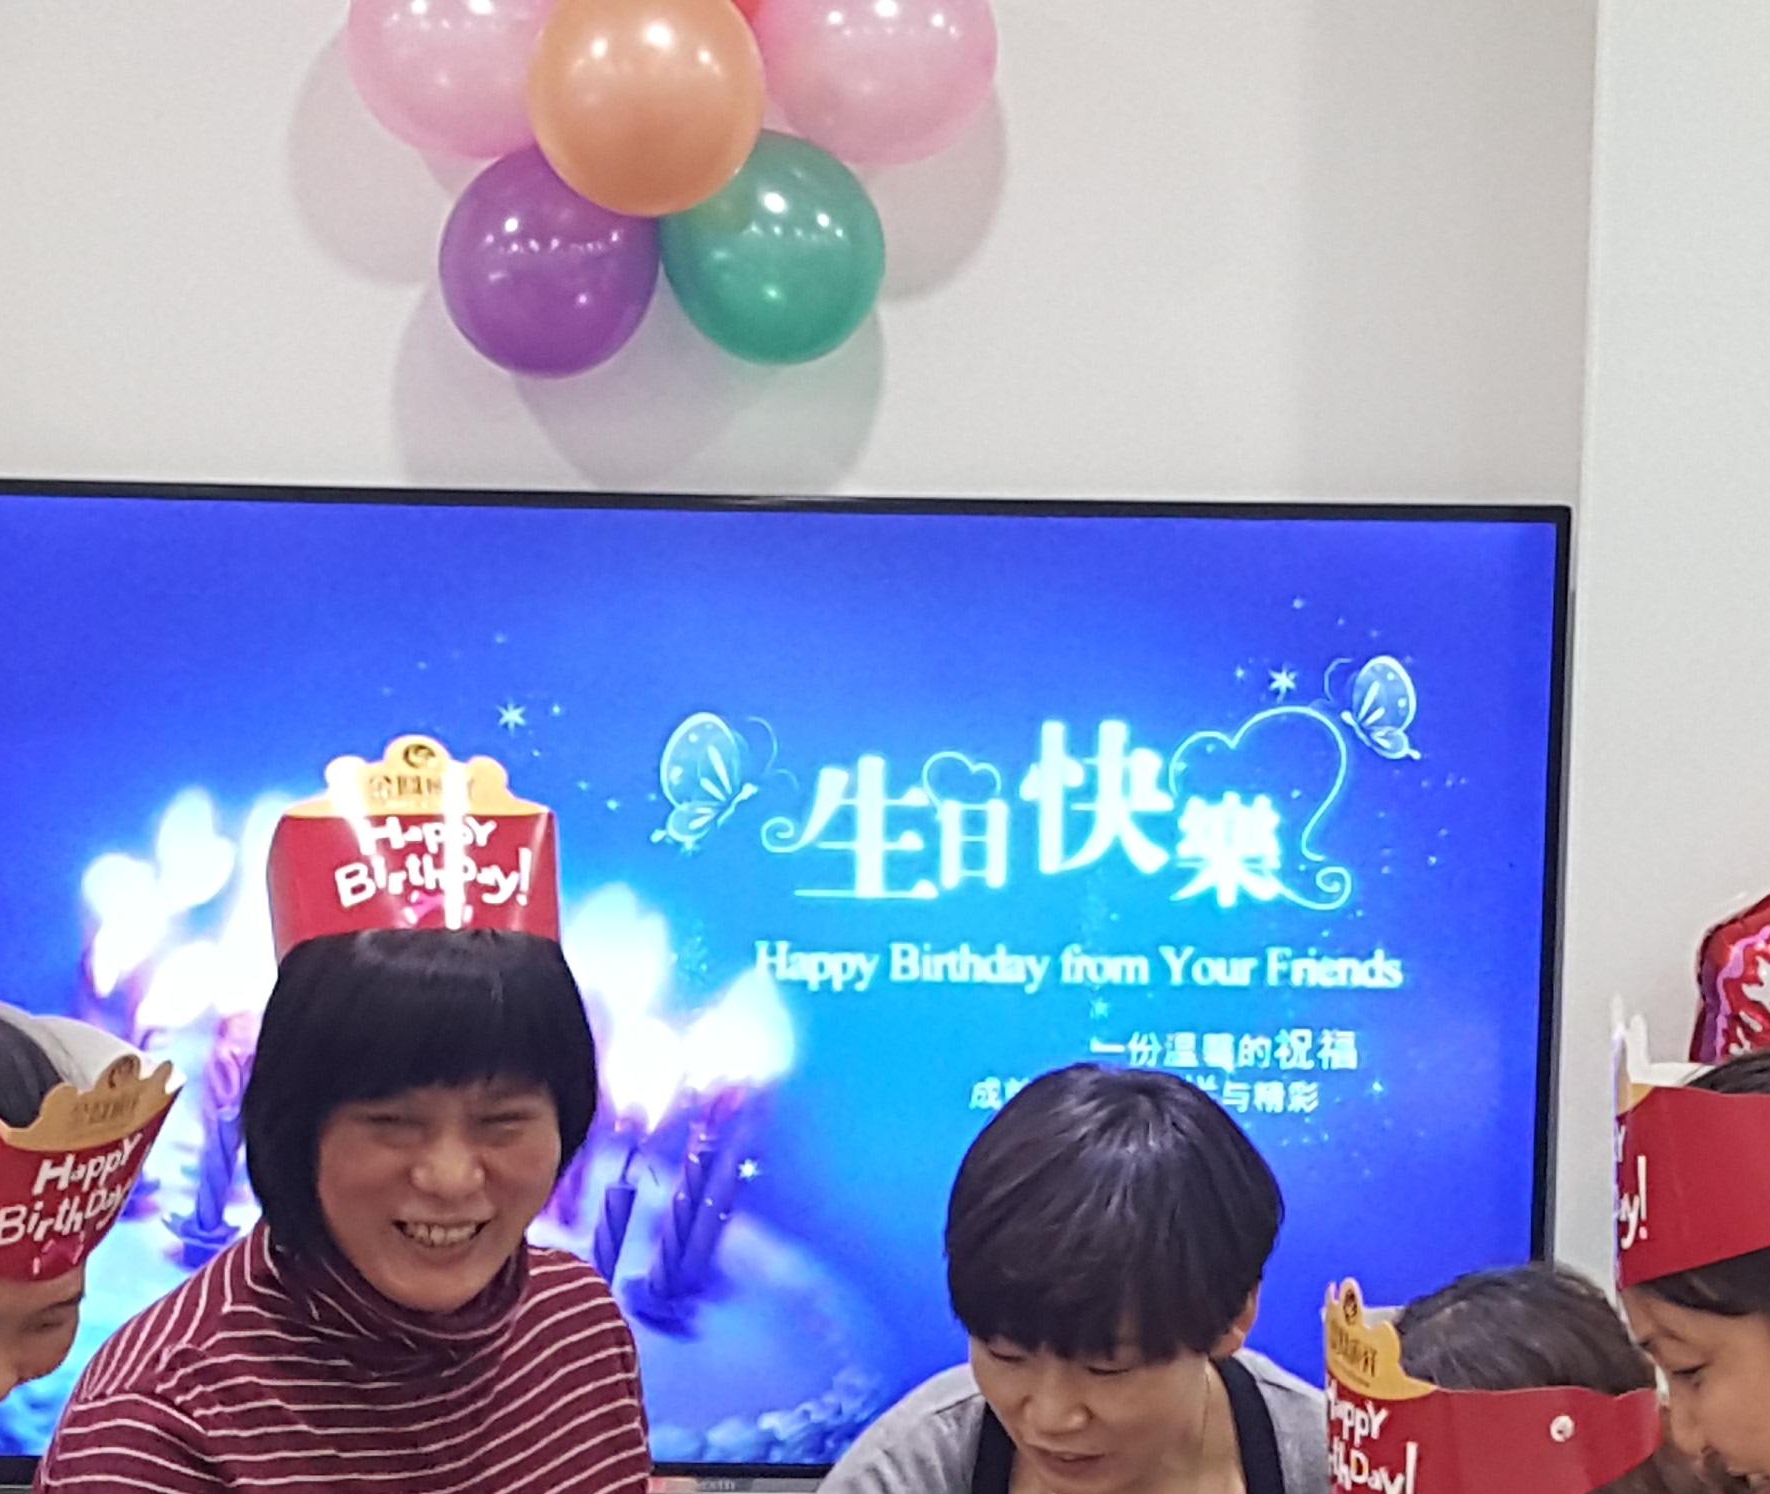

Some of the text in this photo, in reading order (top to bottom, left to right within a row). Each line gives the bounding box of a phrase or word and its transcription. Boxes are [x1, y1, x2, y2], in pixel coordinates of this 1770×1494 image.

[777, 720, 1285, 908] 生日快樂
[755, 940, 1404, 994] Happy Birthday from Your Friends
